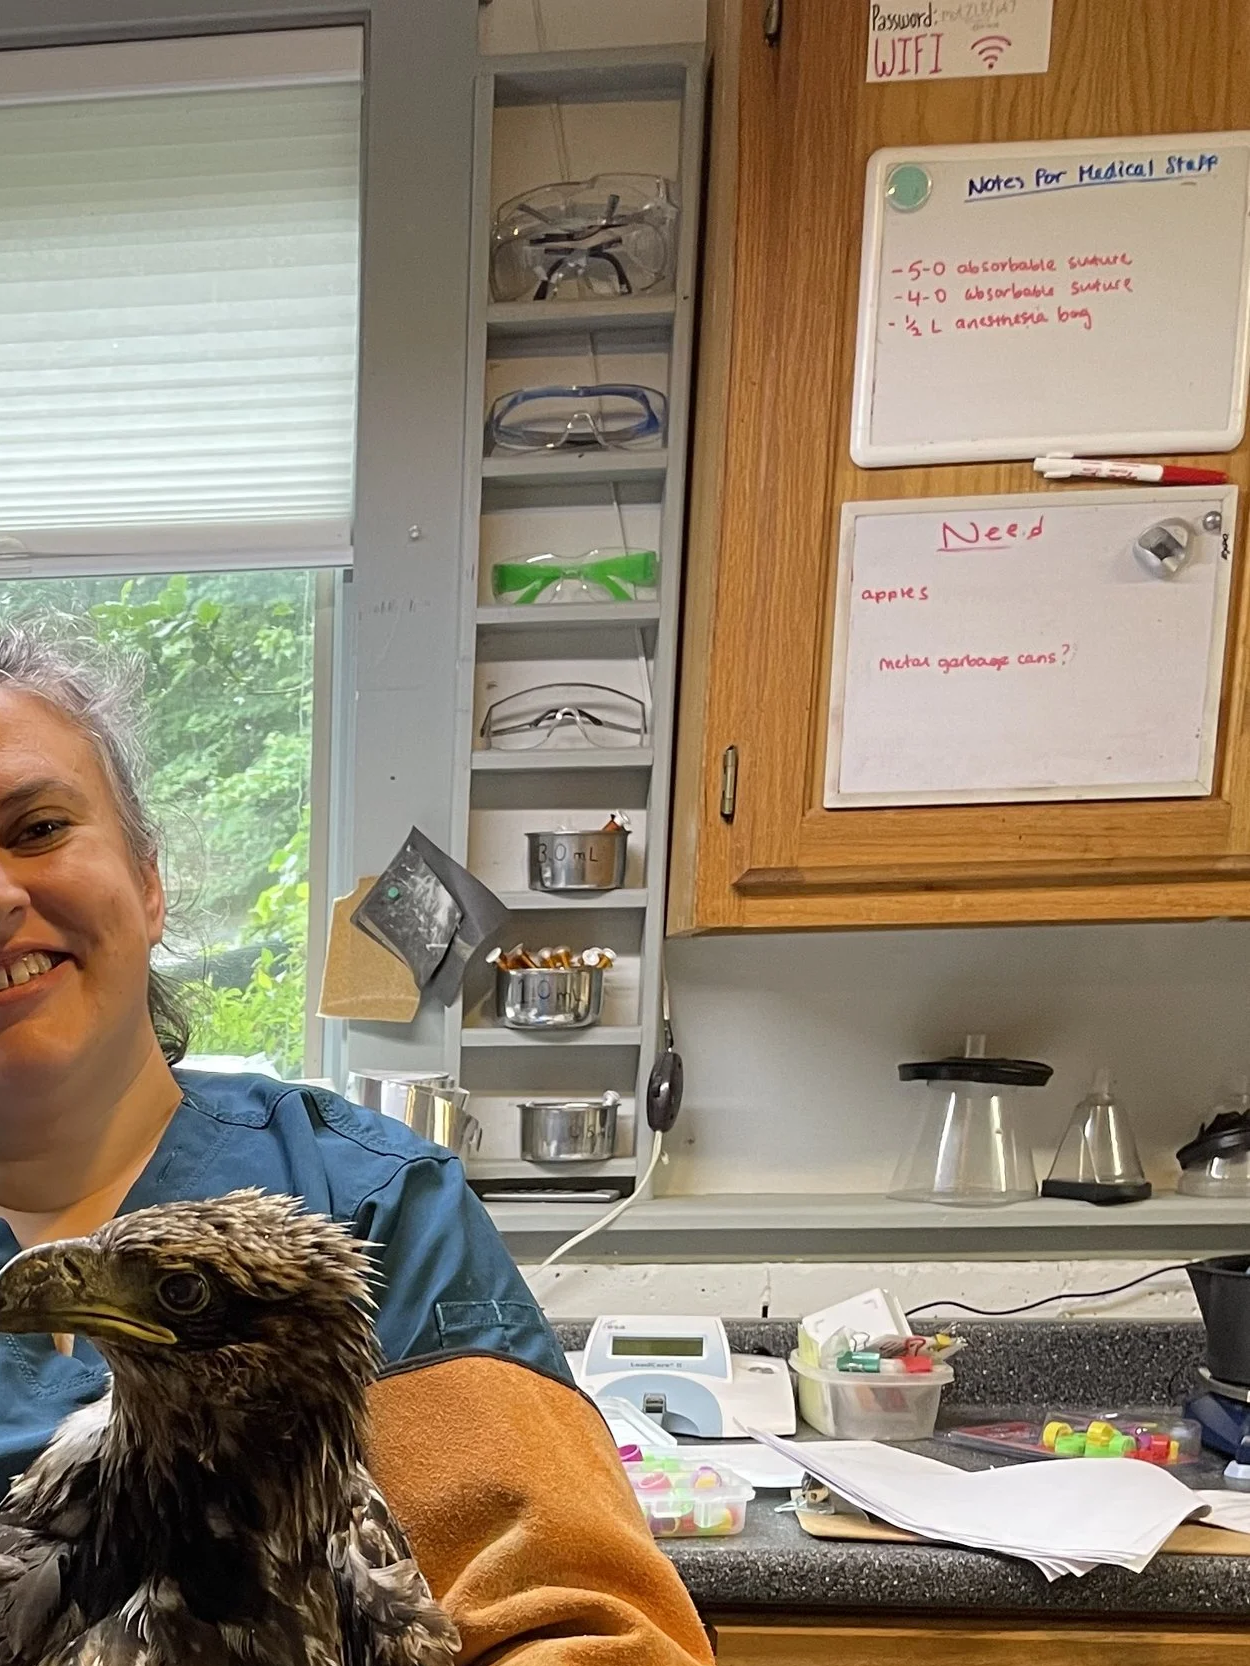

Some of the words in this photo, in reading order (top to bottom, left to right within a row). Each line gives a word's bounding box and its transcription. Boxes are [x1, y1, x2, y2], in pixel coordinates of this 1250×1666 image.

[875, 33, 944, 77] WIFI
[968, 175, 1025, 196] Notes
[1079, 160, 1154, 183] Medical
[957, 257, 1057, 275] absorbable
[1068, 253, 1133, 268] suture
[965, 284, 1054, 301] absorbable
[1071, 276, 1133, 295] suture
[931, 324, 943, 334] L
[942, 515, 1044, 548] Need
[861, 586, 929, 603] apples
[938, 654, 1009, 674] garbage
